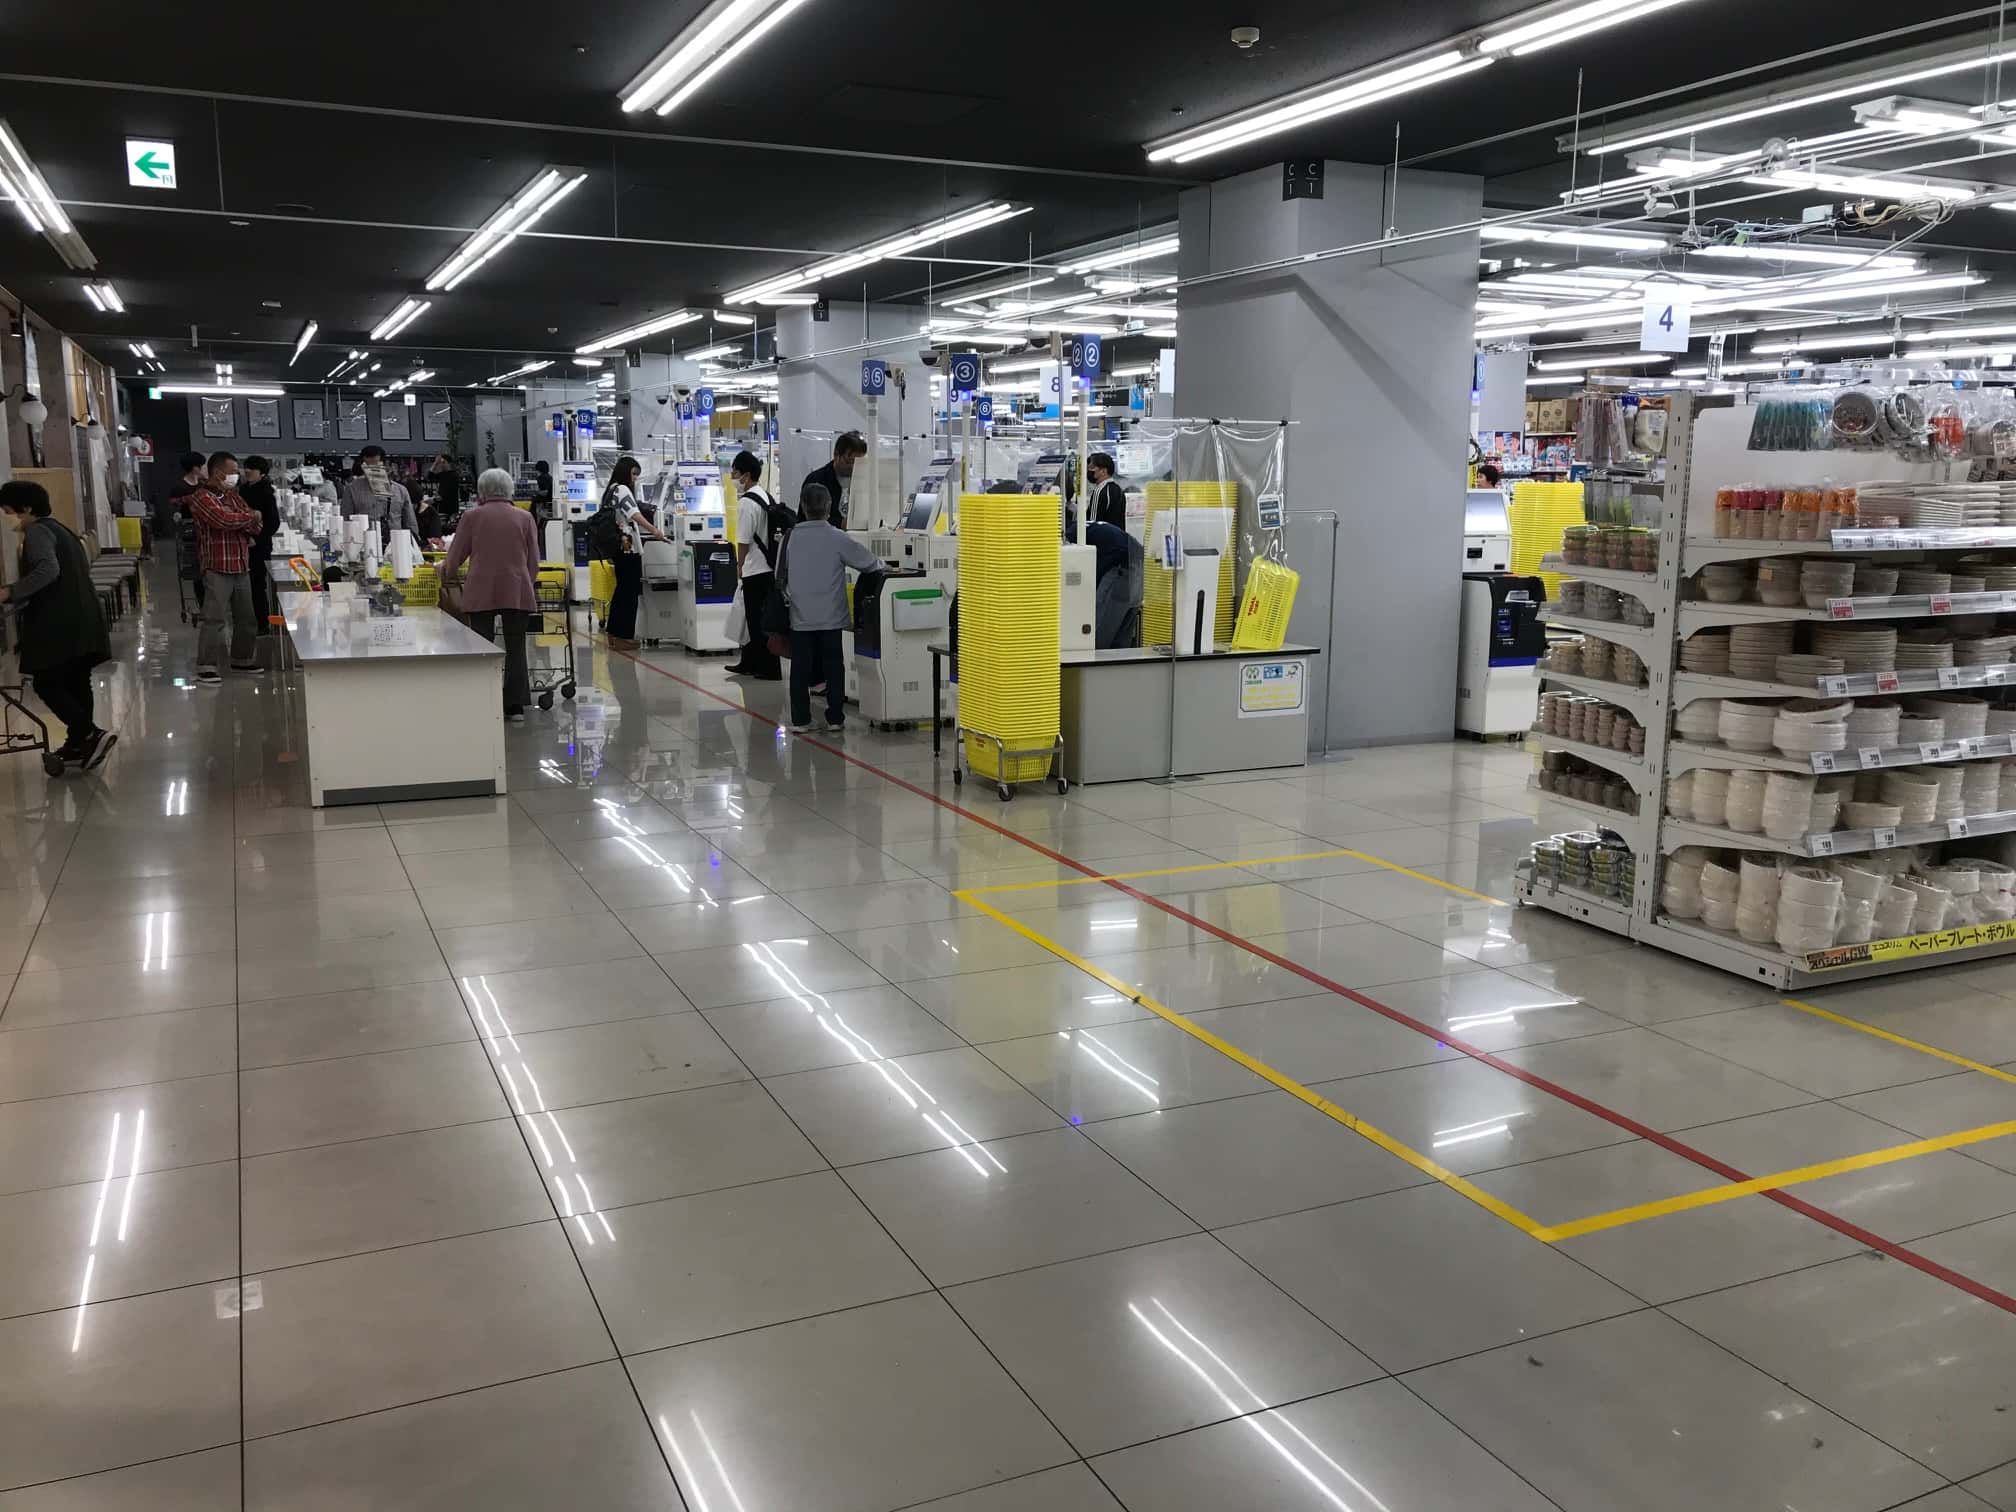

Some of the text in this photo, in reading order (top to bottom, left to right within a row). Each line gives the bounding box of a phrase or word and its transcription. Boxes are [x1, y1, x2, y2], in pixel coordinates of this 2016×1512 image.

[1288, 163, 1295, 176] C
[1308, 163, 1317, 175] C
[1658, 304, 1674, 333] 4
[1051, 376, 1062, 392] 8
